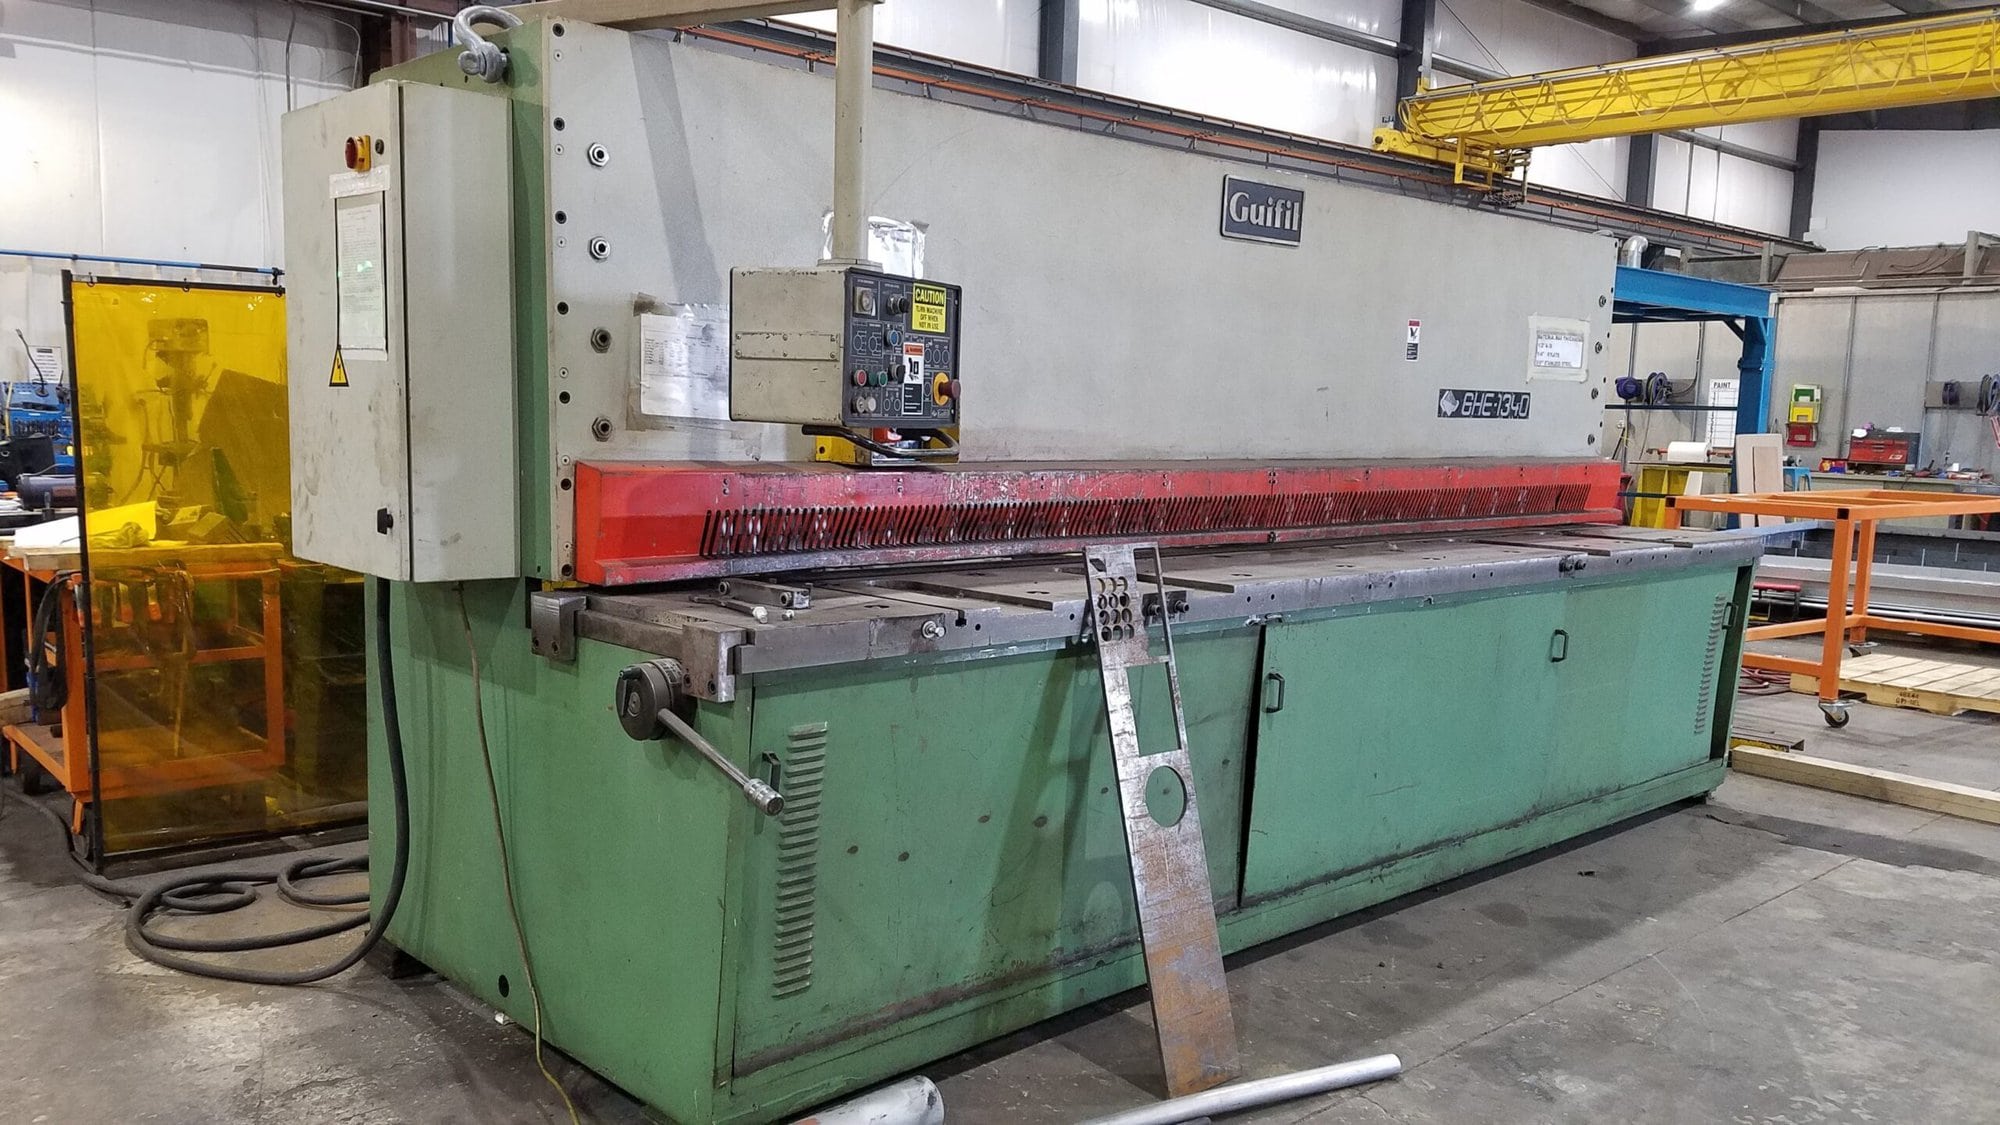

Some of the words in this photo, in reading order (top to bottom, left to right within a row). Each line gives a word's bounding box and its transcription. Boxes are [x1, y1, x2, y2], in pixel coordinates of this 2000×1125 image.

[1229, 191, 1300, 231] Guifil
[915, 288, 944, 305] CAUTION
[915, 305, 926, 313] TURN
[926, 306, 943, 315] MACHINE
[928, 314, 939, 322] WHEN
[1713, 381, 1731, 389] PAINT
